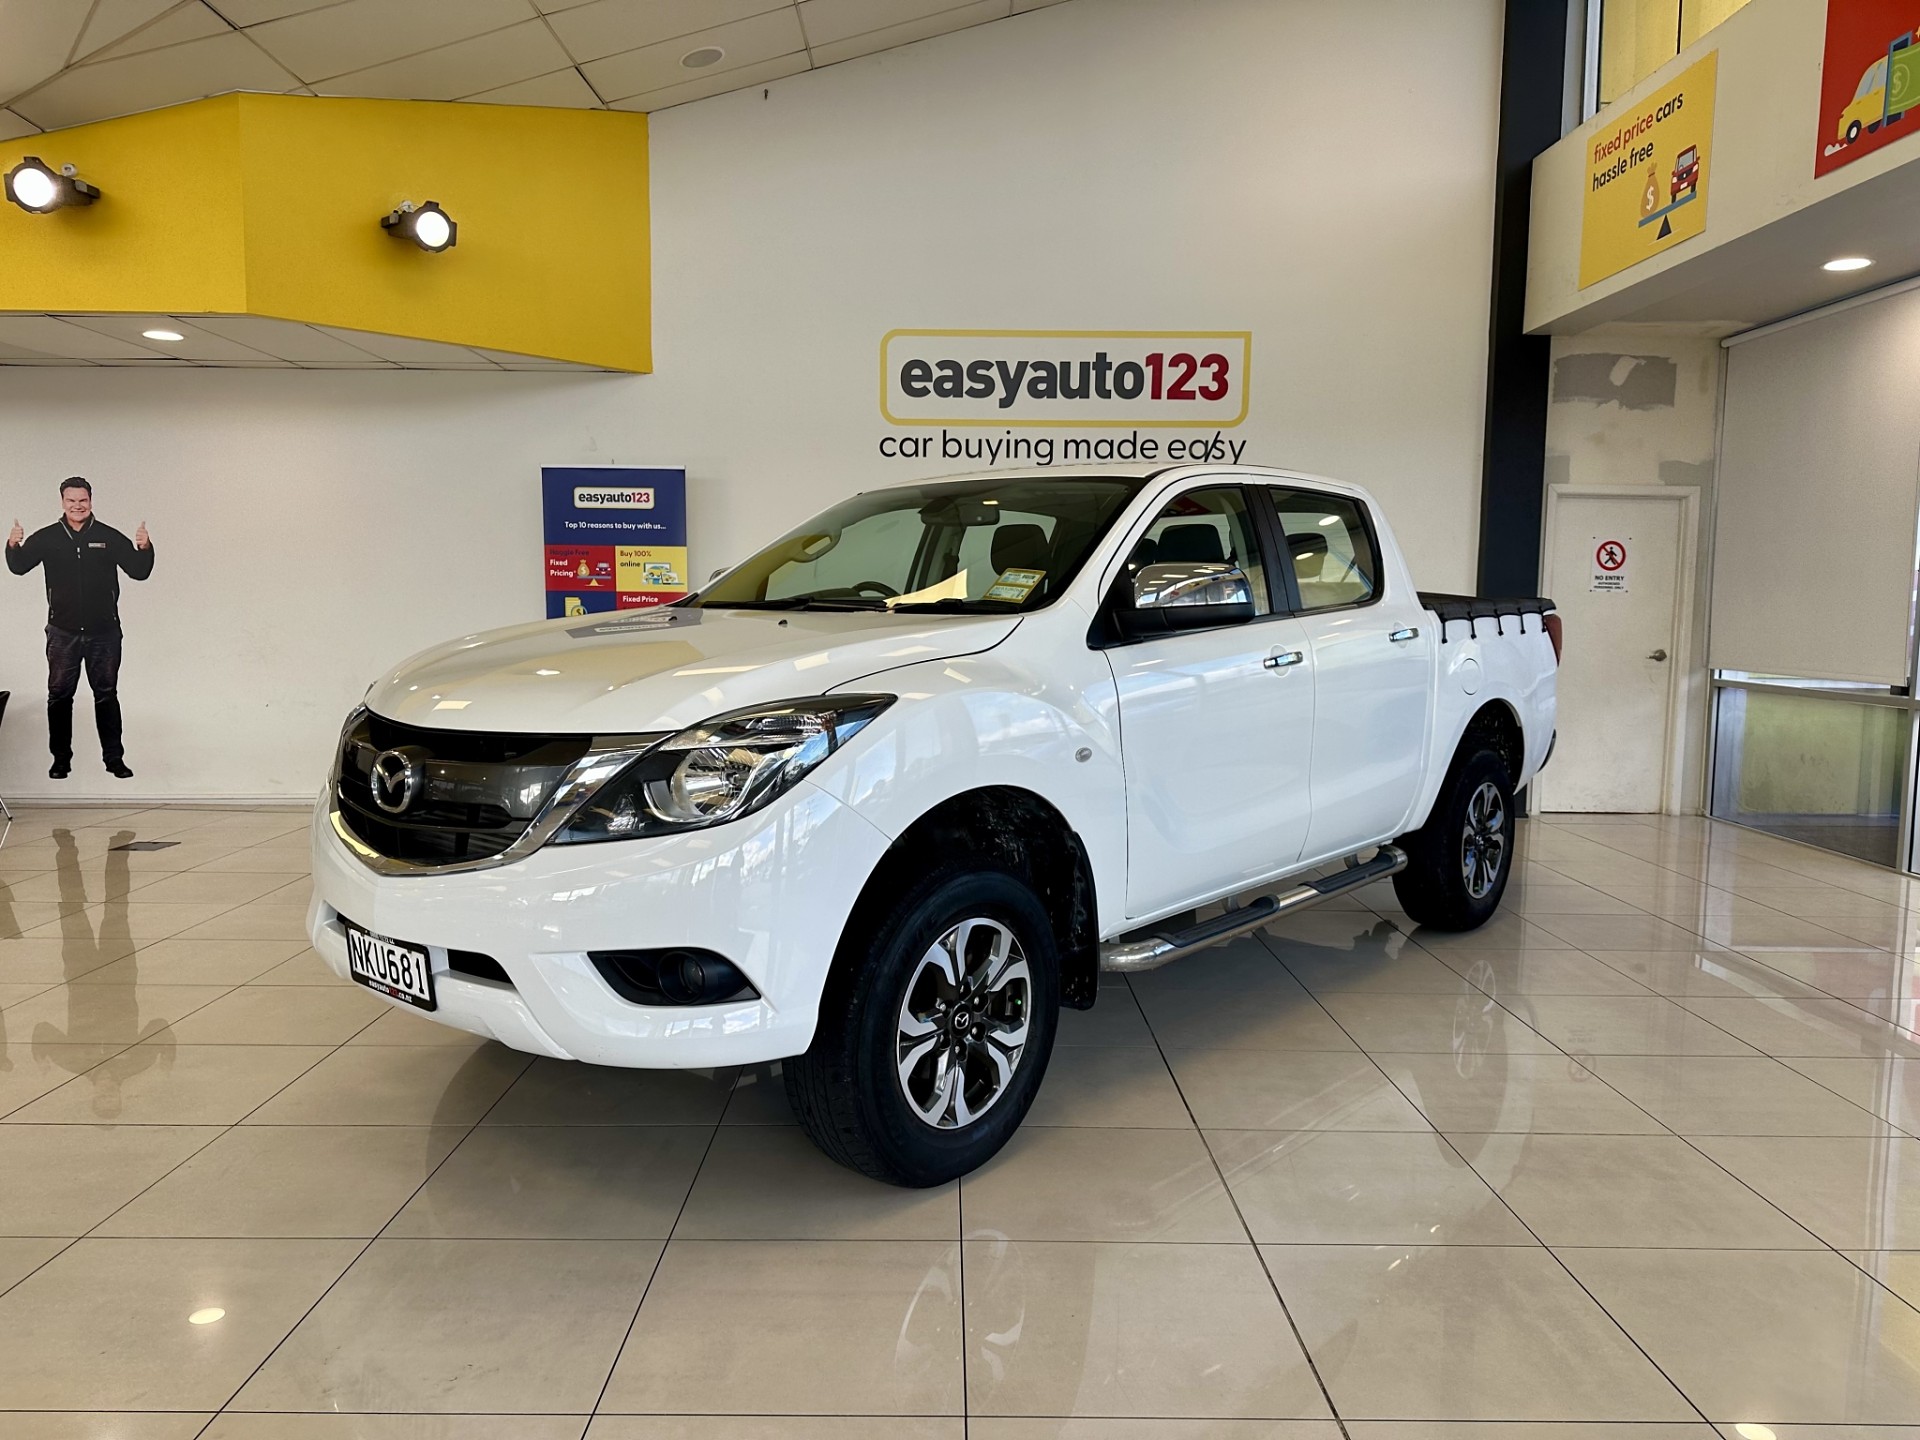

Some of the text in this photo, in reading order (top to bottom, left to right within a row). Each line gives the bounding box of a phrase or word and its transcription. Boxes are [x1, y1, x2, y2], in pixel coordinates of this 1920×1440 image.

[1594, 93, 1683, 164] fixed price cars
[1592, 142, 1654, 192] hassle free
[900, 351, 1230, 409] easyauto123
[879, 430, 1247, 466] car buying made easy
[578, 492, 650, 504] easyauto123
[565, 521, 578, 529] Top
[622, 522, 636, 531] buy
[636, 522, 652, 530] with
[549, 558, 568, 566] Fixed
[620, 550, 633, 558] Buy
[622, 595, 659, 603] Fixed Price
[351, 934, 425, 994] NKU681
